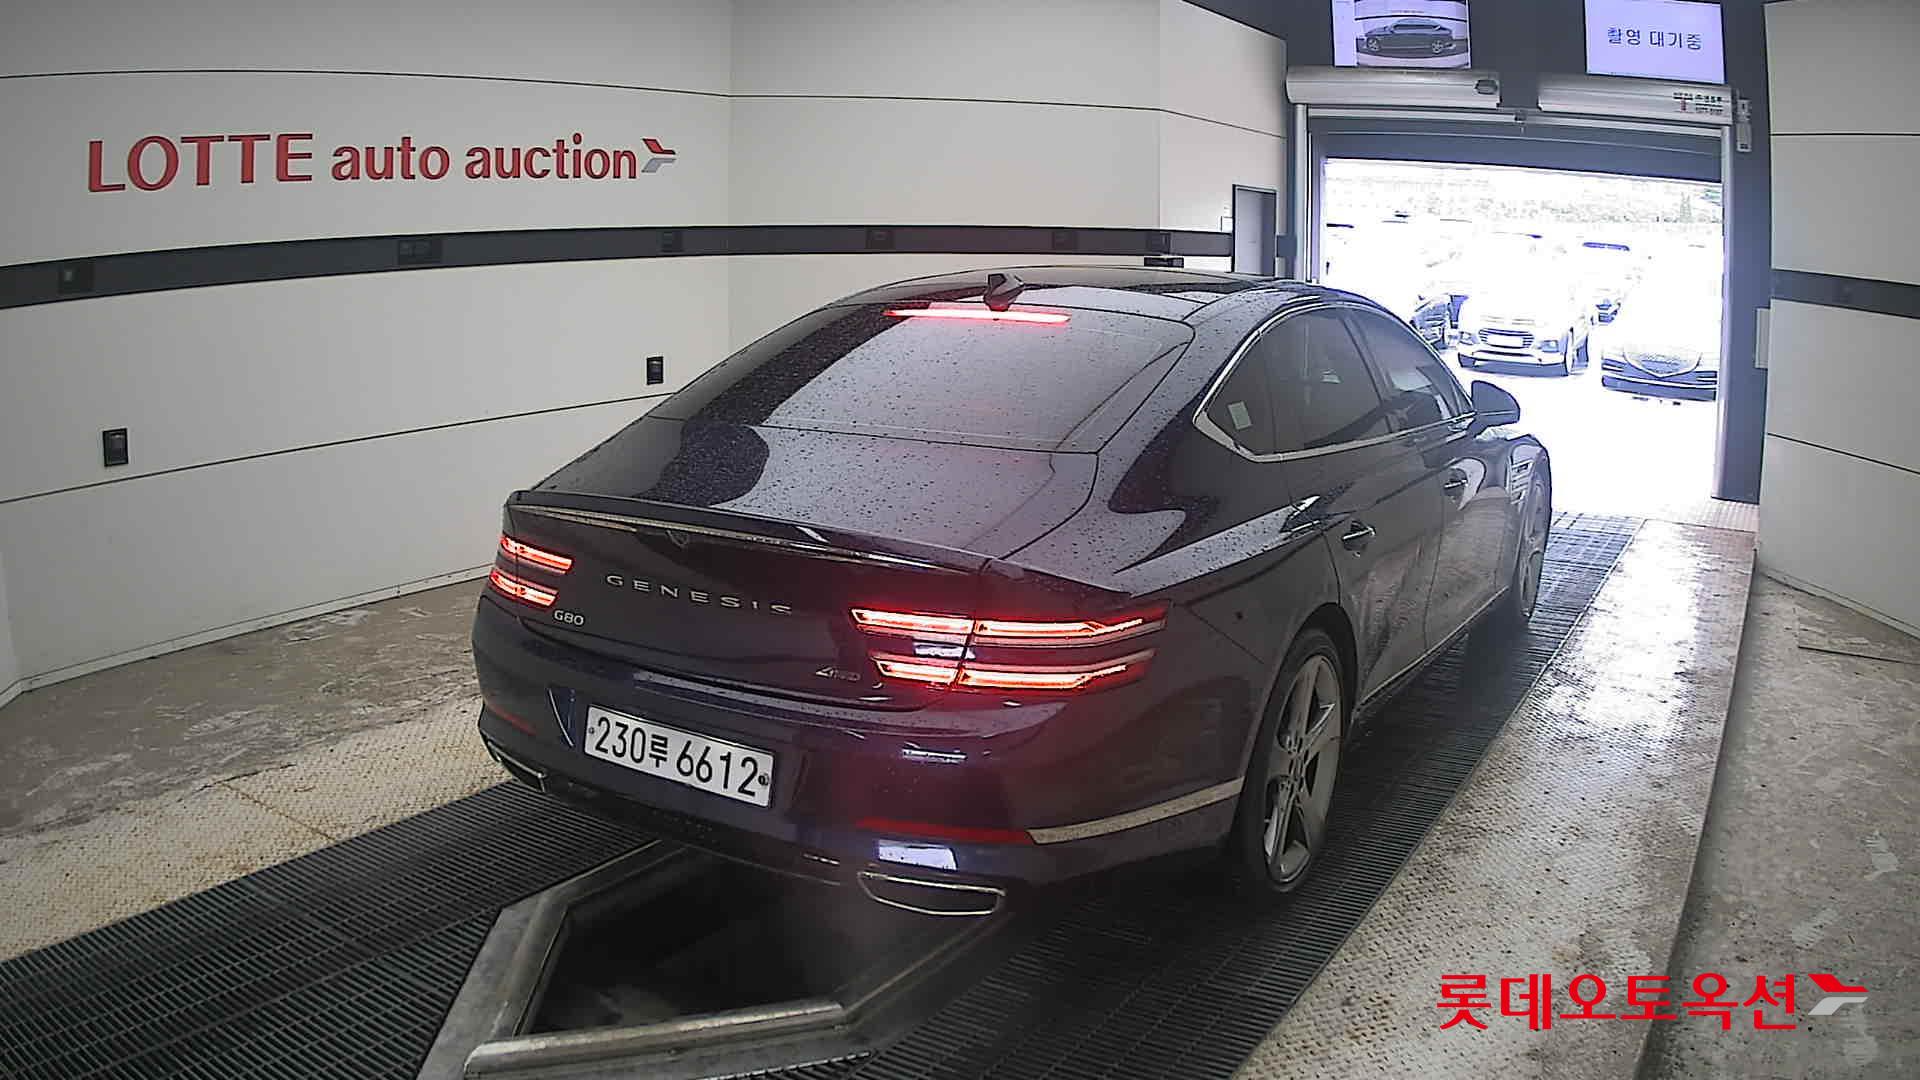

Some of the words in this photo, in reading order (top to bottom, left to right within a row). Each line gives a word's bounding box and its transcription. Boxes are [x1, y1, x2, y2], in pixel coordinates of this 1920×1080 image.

[1649, 30, 1702, 51] 대기중
[88, 133, 313, 193] LOTTE
[331, 135, 450, 181] auto
[464, 133, 638, 180] auction
[605, 574, 793, 616] GENESIS
[553, 609, 585, 627] G80
[676, 739, 759, 798] 6612
